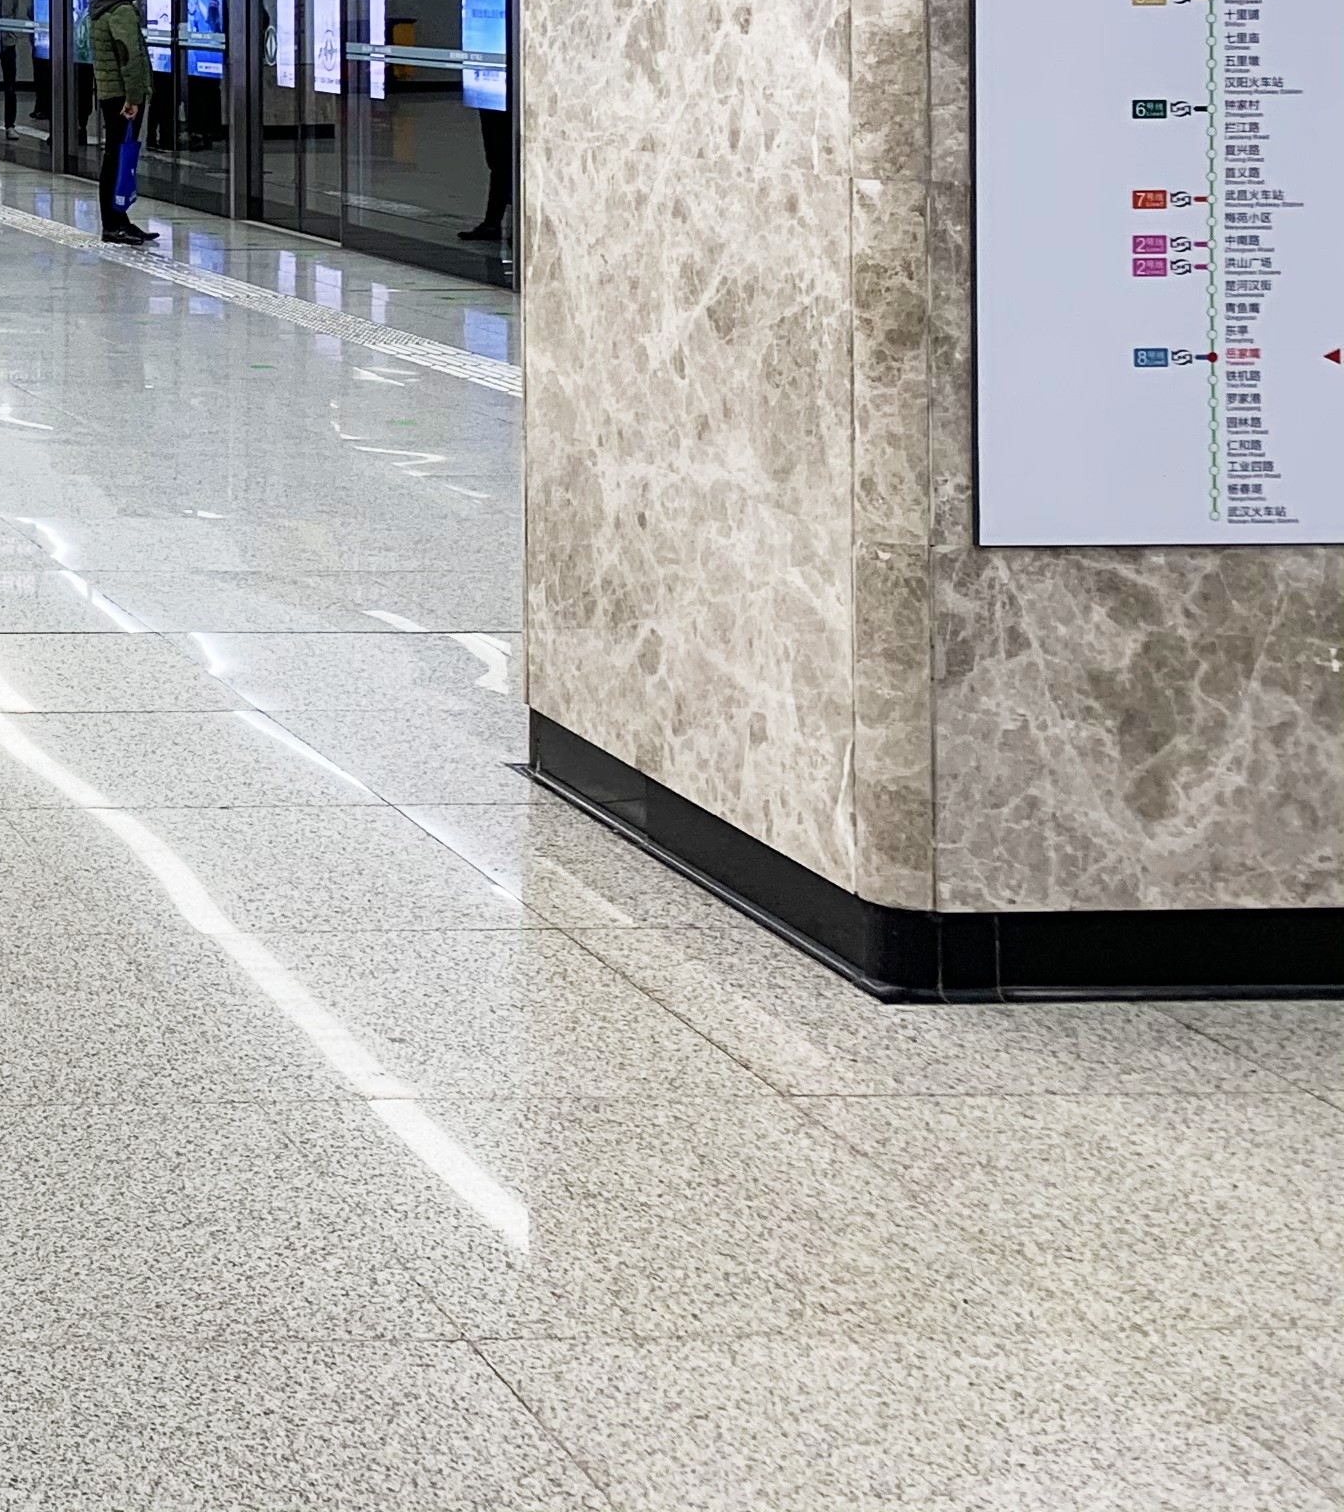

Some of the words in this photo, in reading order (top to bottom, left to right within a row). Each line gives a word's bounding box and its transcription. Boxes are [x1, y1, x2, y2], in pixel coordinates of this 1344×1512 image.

[1224, 76, 1284, 89] 汉阳火车站
[1227, 506, 1287, 518] 武汉火车站
